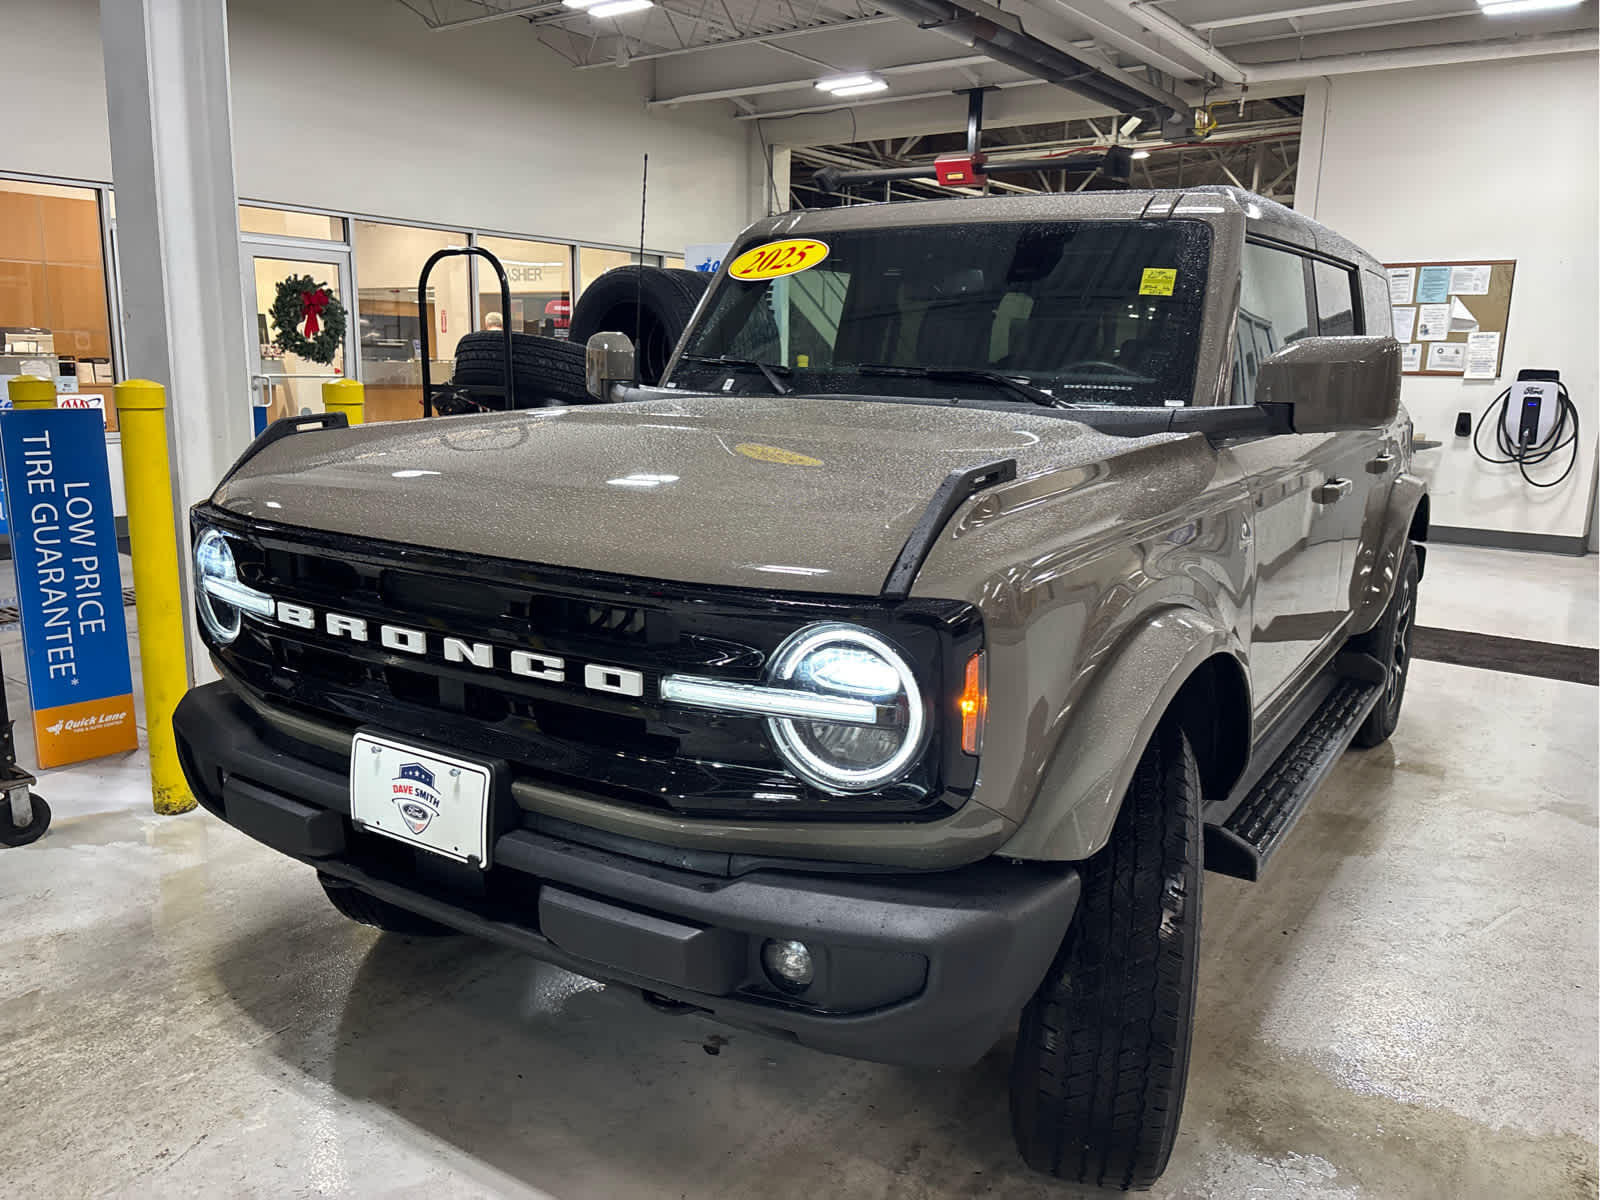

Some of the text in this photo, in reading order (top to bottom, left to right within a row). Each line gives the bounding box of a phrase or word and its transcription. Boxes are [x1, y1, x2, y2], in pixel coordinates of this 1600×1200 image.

[739, 244, 817, 275] 2025
[505, 267, 544, 281] ASHIER
[1523, 386, 1545, 395] Ford
[22, 430, 56, 494] TIRE
[63, 482, 106, 636] LOW PRICE
[277, 601, 644, 697] BRONCO
[65, 716, 97, 731] Quick
[98, 712, 127, 724] Lane
[392, 784, 440, 808] DAVE SMITH
